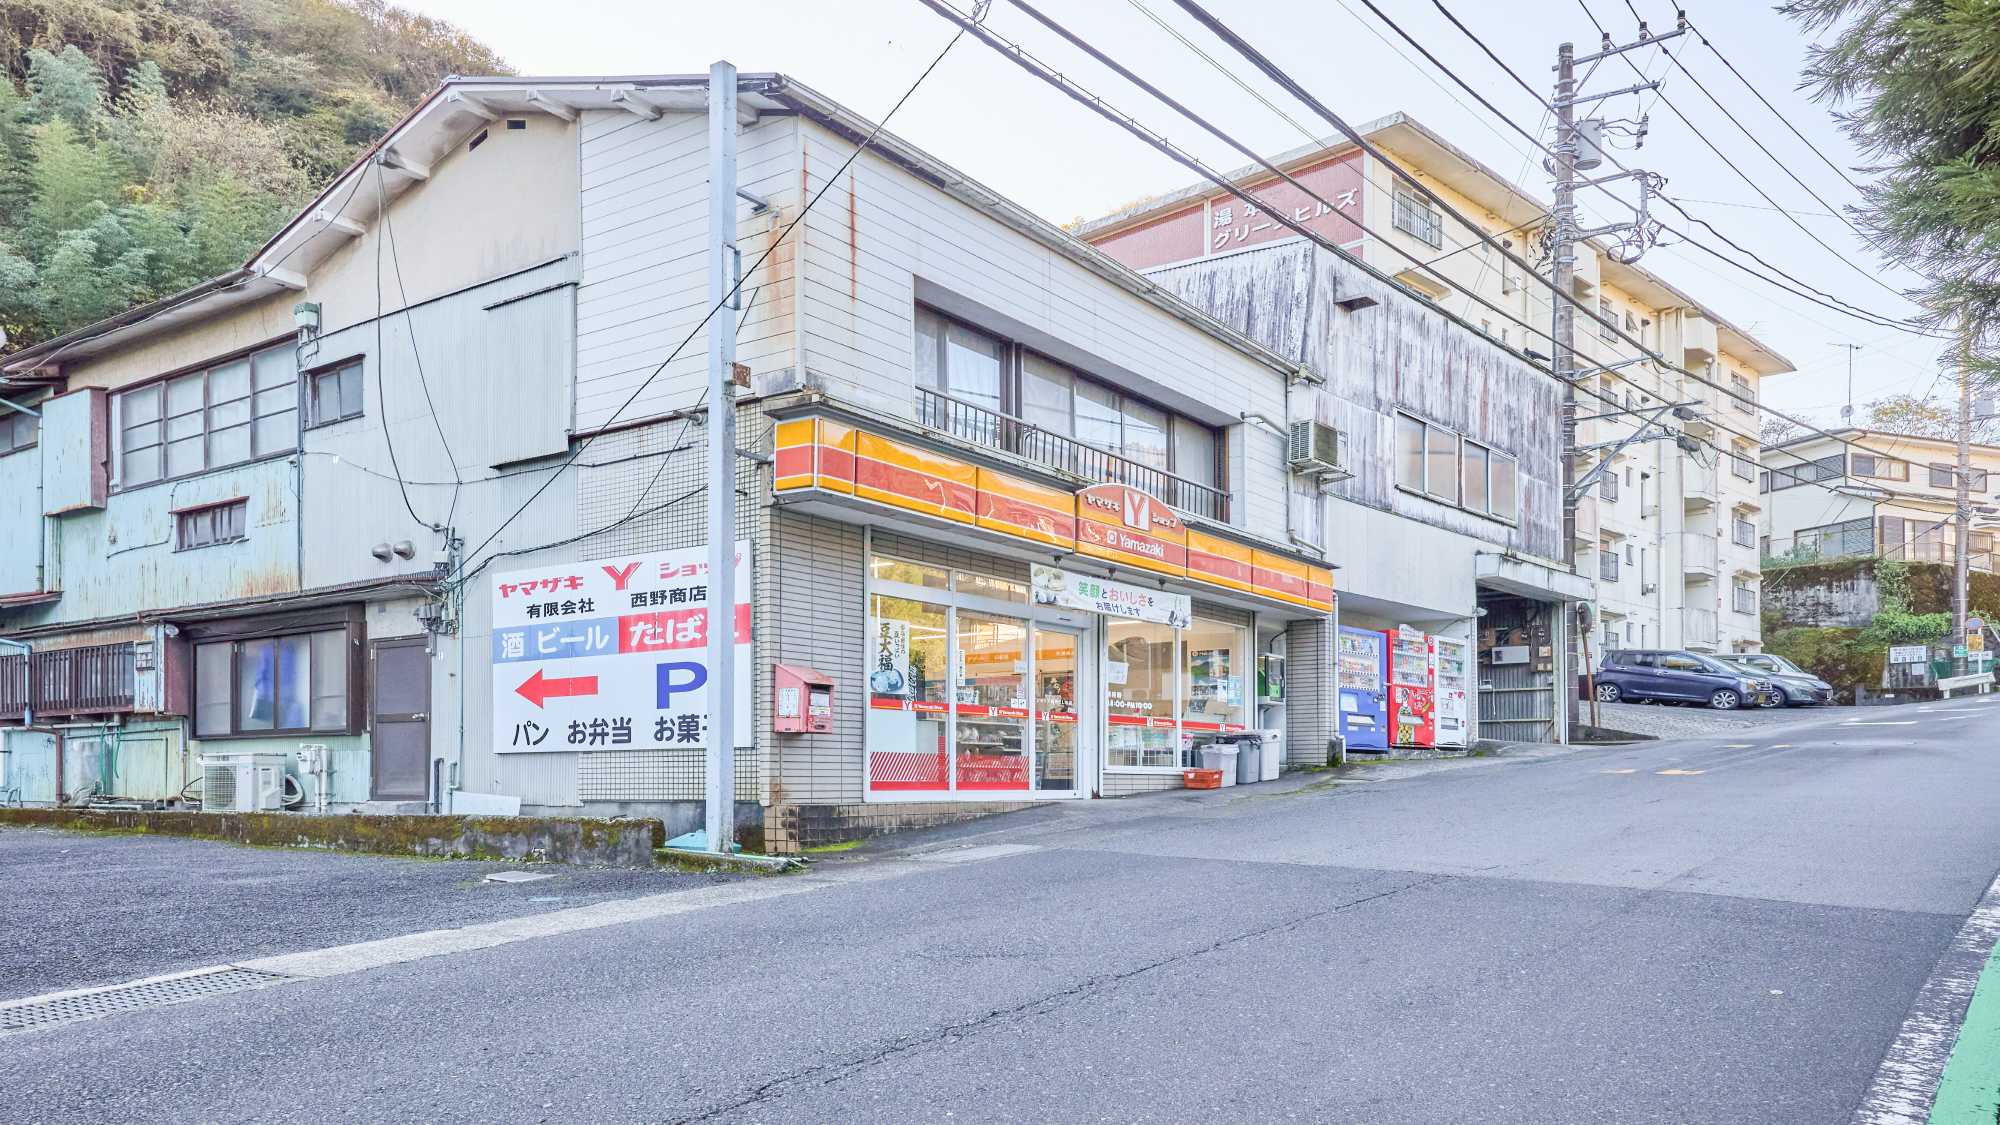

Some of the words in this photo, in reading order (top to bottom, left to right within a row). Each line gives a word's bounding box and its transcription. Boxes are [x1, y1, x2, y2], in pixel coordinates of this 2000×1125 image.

[1085, 493, 1121, 512] ヤマザキ
[1126, 490, 1147, 528] Y
[1151, 511, 1179, 528] ショップ
[1119, 533, 1165, 558] Yamazaki
[498, 575, 584, 599] ヤマザキ
[601, 562, 643, 590] Y
[1078, 580, 1155, 607] 笑顔とおいしさを
[526, 597, 595, 619] 有限会社
[630, 585, 707, 608] 西野商店
[1095, 601, 1141, 617] お届けします
[501, 632, 525, 659] 酒
[537, 624, 609, 654] ビール
[629, 613, 740, 647] たば
[878, 622, 894, 672] 豆大福
[656, 661, 708, 710] P
[513, 720, 550, 746] パン
[567, 716, 633, 746] お弁当
